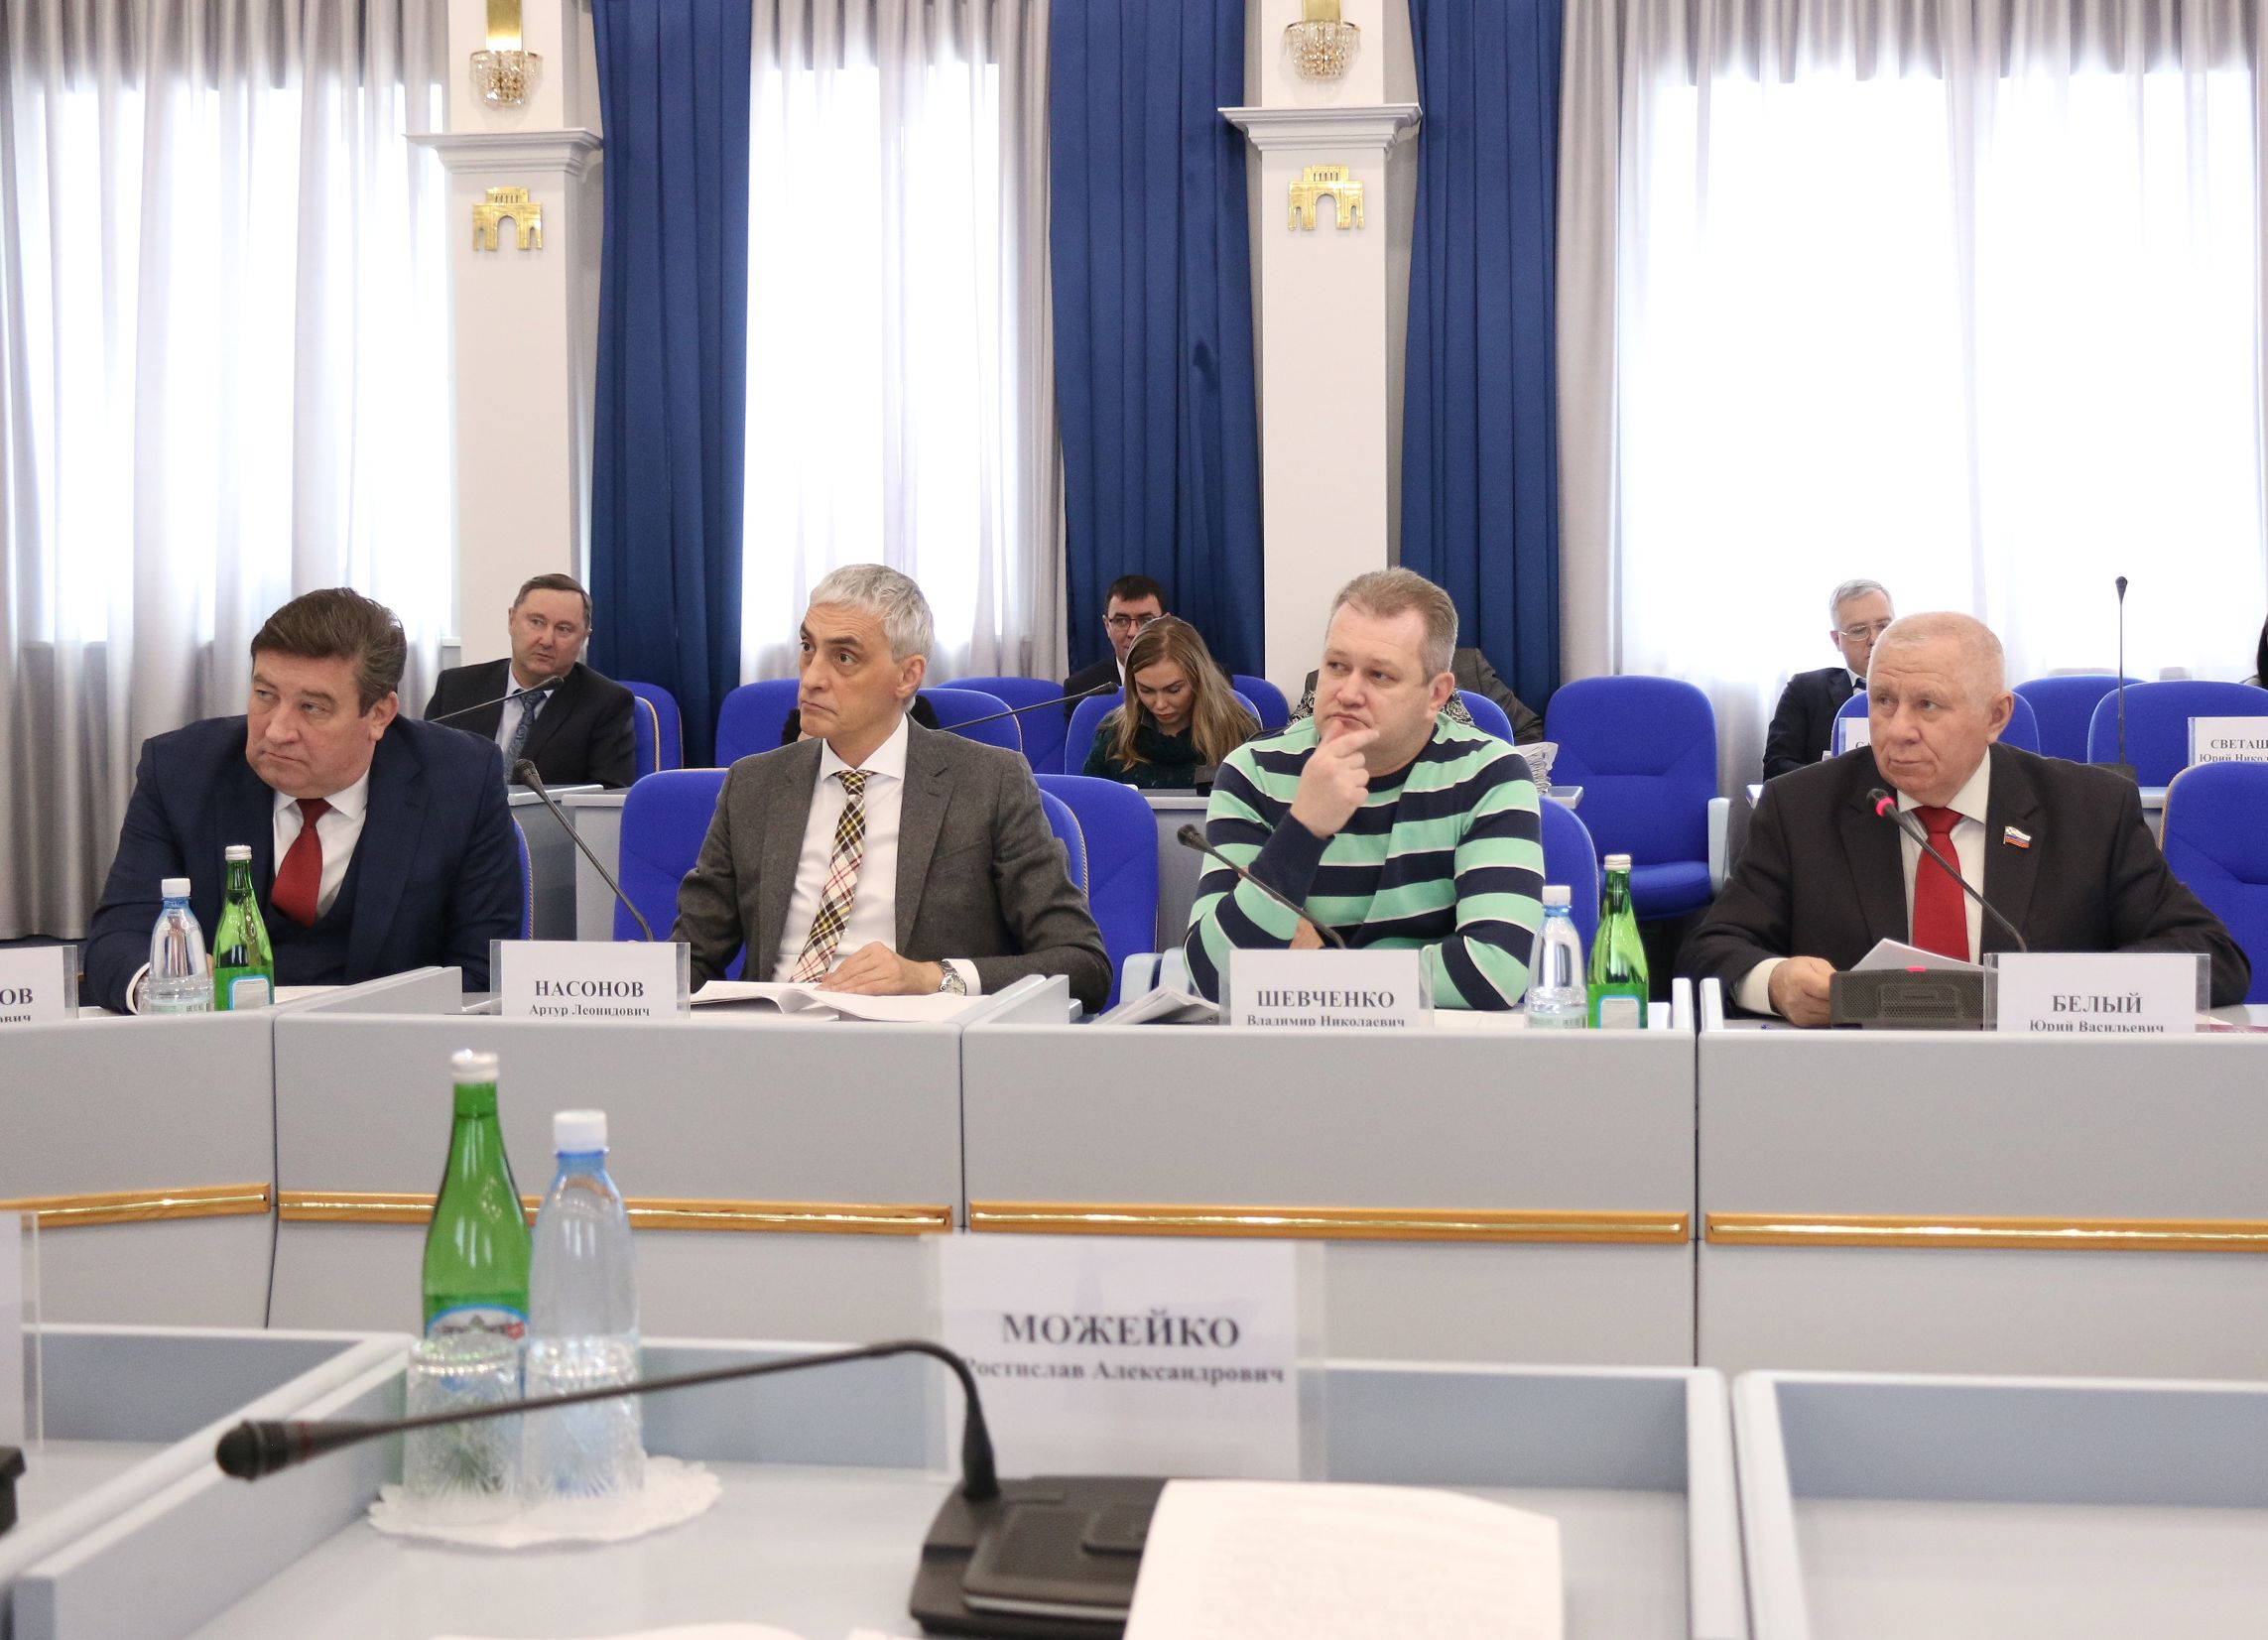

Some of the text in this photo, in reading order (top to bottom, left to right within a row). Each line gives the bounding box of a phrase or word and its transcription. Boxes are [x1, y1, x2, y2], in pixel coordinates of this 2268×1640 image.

[535, 980, 645, 997] НАСОНОВ
[1257, 990, 1395, 1008] ШЕВЧЕНКО
[2052, 991, 2143, 1014] БЕЛЫЙ
[529, 1004, 650, 1017] Артур Леонидович
[1247, 1014, 1405, 1027] Владимир Николаевич
[2029, 1020, 2165, 1033] Юрий Васильевич
[1002, 1309, 1240, 1347] МОЖЕЙКО
[1093, 1360, 1285, 1387] Александрович
